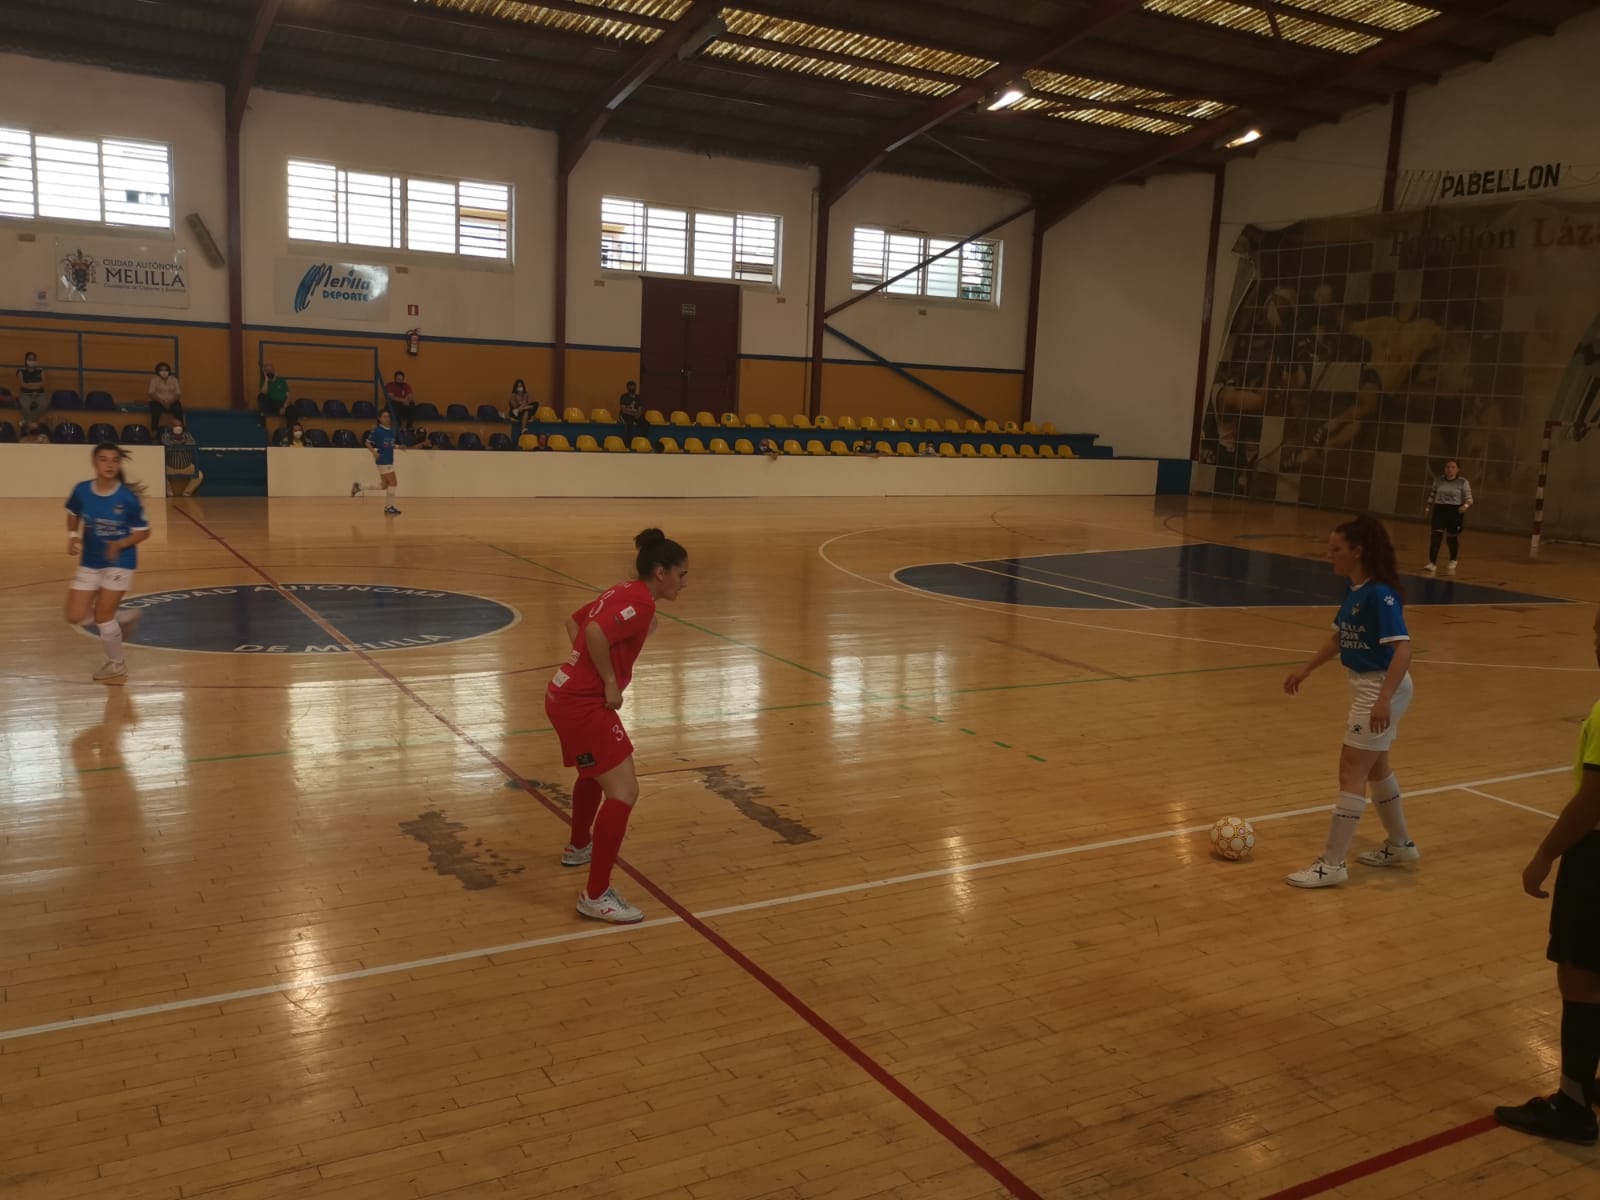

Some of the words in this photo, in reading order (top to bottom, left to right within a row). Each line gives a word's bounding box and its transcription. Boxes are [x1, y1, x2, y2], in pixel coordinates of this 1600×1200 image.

[1440, 162, 1561, 198] PABELLON
[1531, 216, 1600, 249] Láz
[102, 258, 134, 268] CIUDAD
[105, 267, 185, 288] MELILLA
[322, 290, 369, 302] DEPORTE
[233, 644, 289, 654] DE
[304, 634, 454, 653] MELILLA
[612, 724, 624, 742] 3
